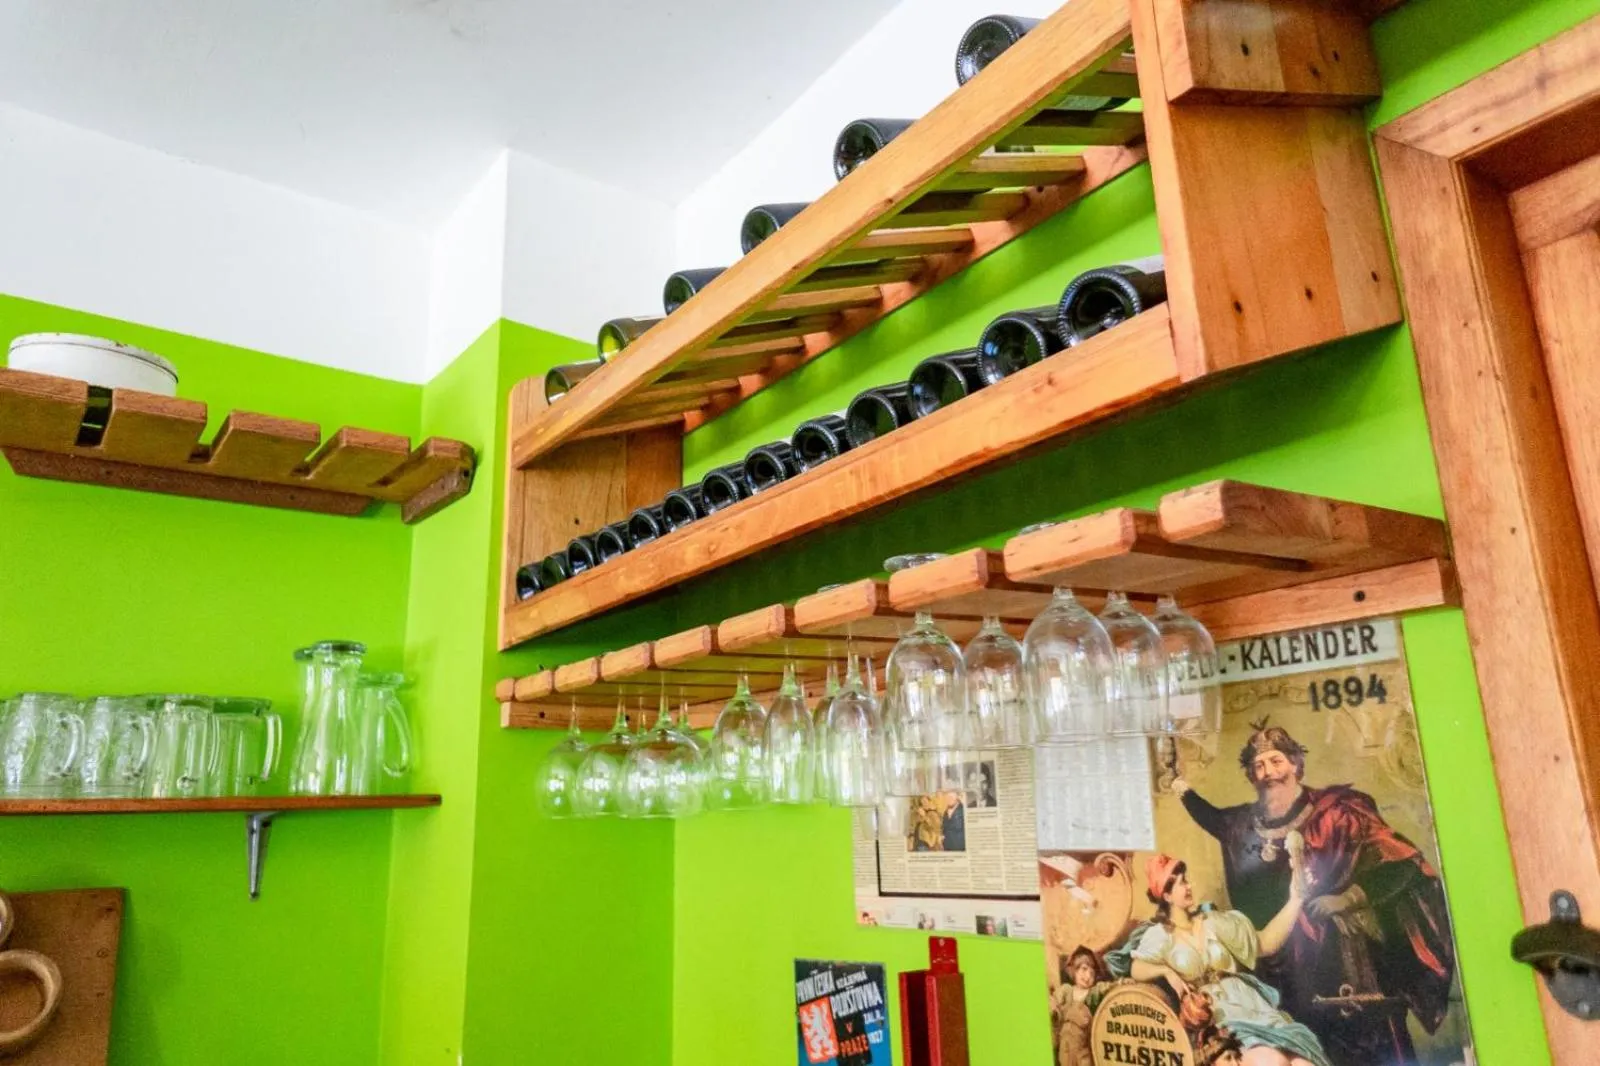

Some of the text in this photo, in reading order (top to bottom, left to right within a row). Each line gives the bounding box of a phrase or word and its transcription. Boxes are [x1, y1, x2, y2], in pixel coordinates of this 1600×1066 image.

[1308, 673, 1388, 711] 1894
[1107, 1021, 1175, 1042] BRAUHAUS
[1103, 1041, 1184, 1066] PILSEN
